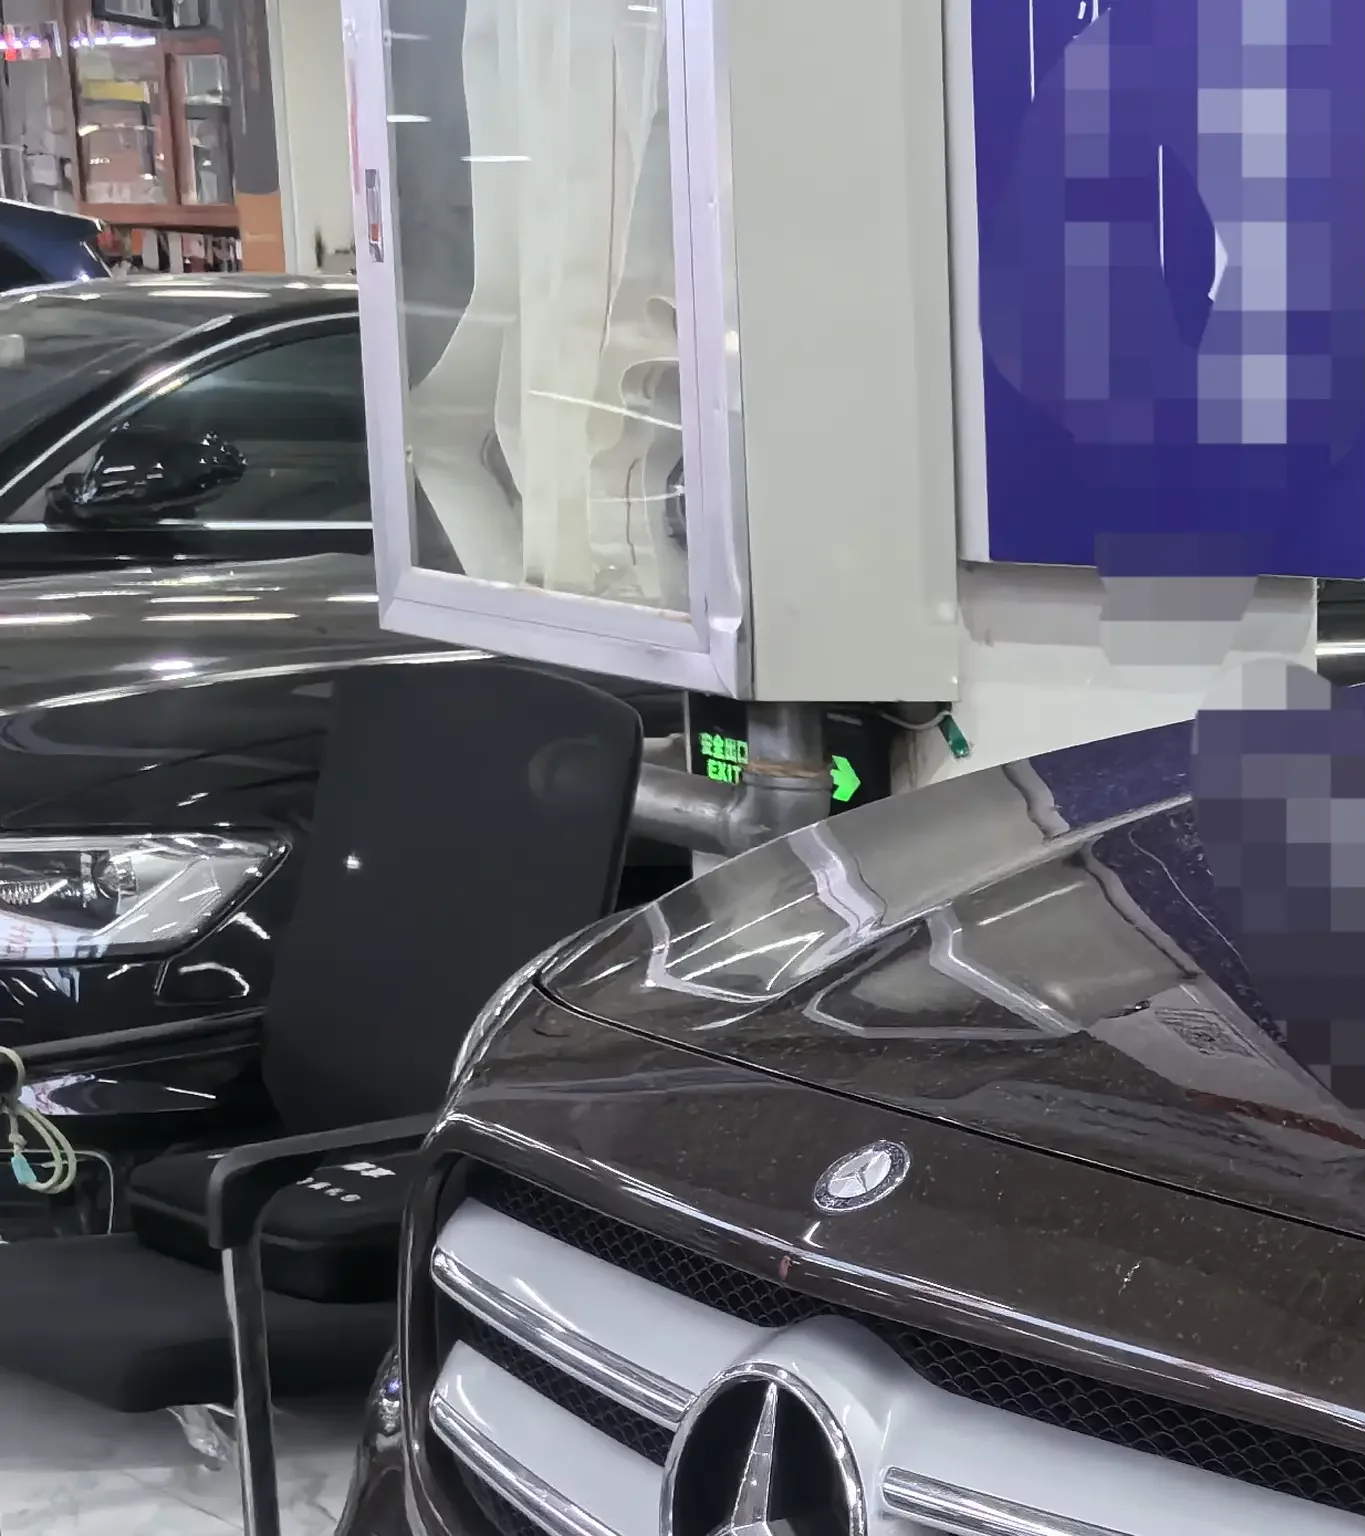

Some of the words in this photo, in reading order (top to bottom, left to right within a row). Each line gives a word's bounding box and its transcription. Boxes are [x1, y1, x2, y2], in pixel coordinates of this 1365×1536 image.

[699, 731, 748, 764] 安全出口
[707, 757, 741, 784] EXIT
